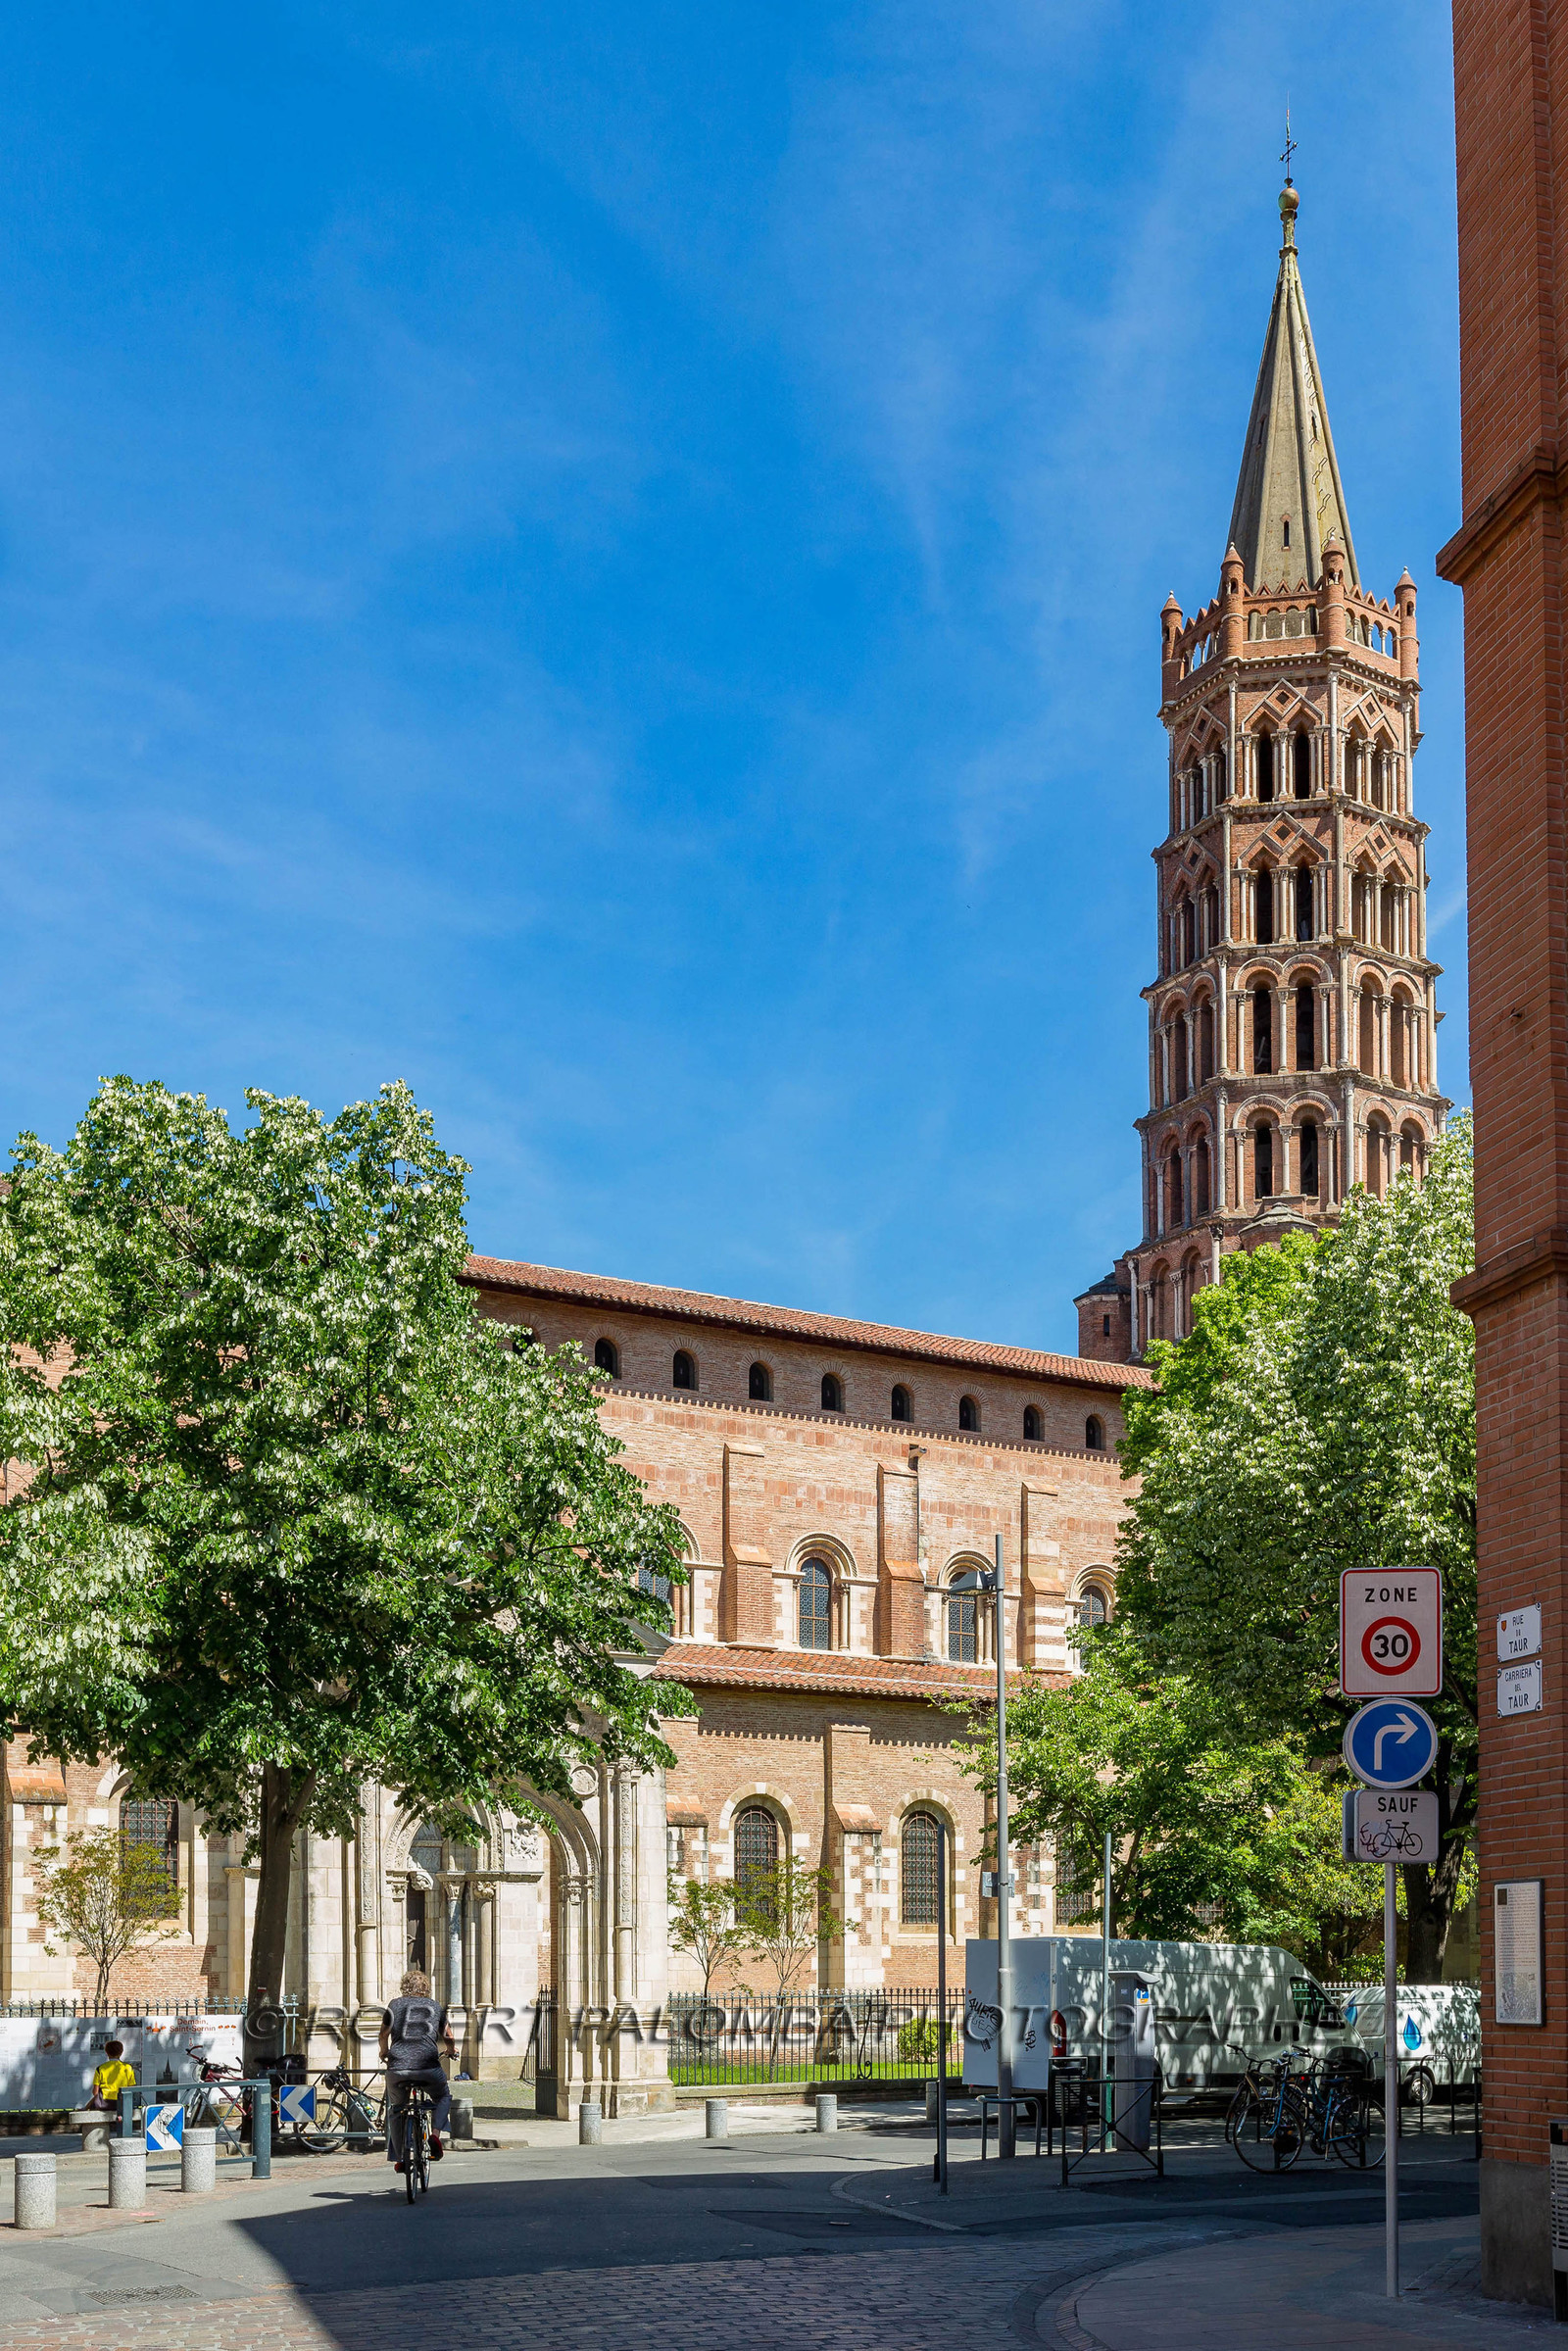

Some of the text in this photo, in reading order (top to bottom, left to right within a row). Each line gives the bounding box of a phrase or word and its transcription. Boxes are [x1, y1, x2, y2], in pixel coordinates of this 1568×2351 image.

[1365, 1588, 1417, 1602] ZONE
[1512, 1614, 1524, 1627] RUE
[1374, 1634, 1408, 1658] 30
[1509, 1638, 1528, 1653] TAUR
[1508, 1693, 1529, 1709] TAUR
[1377, 1796, 1418, 1813] SAUF
